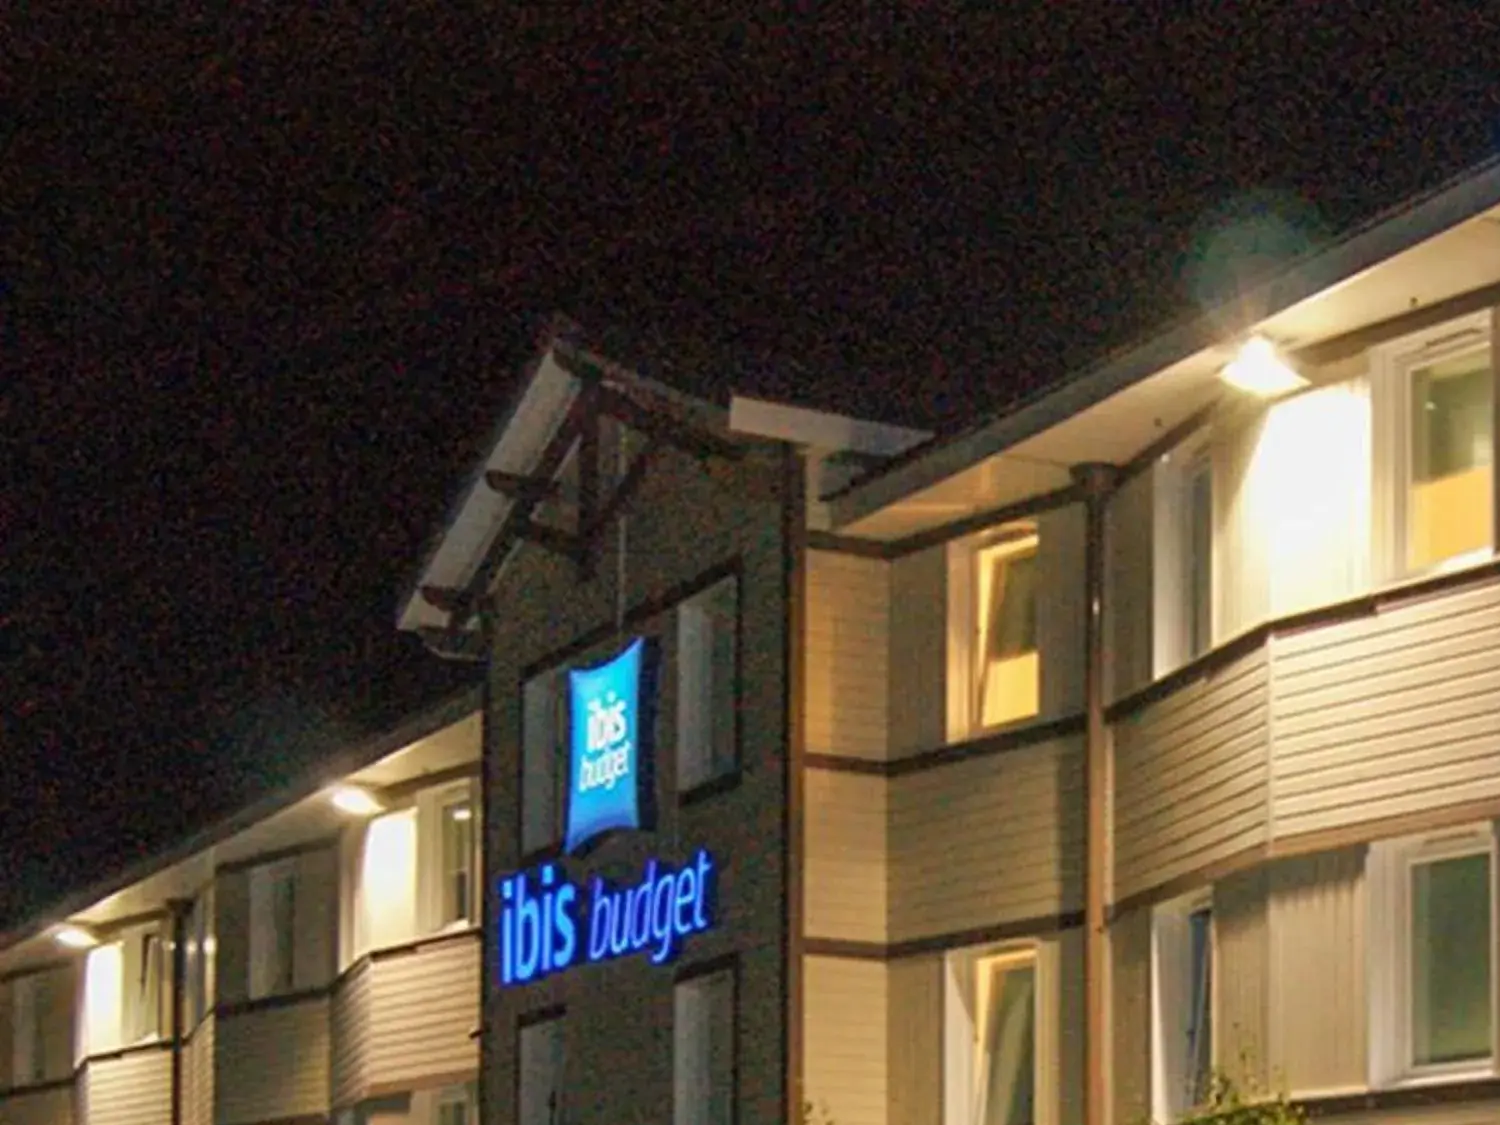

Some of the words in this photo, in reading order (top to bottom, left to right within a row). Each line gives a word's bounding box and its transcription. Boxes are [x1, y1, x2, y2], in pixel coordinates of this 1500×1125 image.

[587, 691, 627, 753] ibis
[579, 740, 631, 791] budget
[502, 865, 577, 983] ibis
[589, 850, 713, 963] budget
